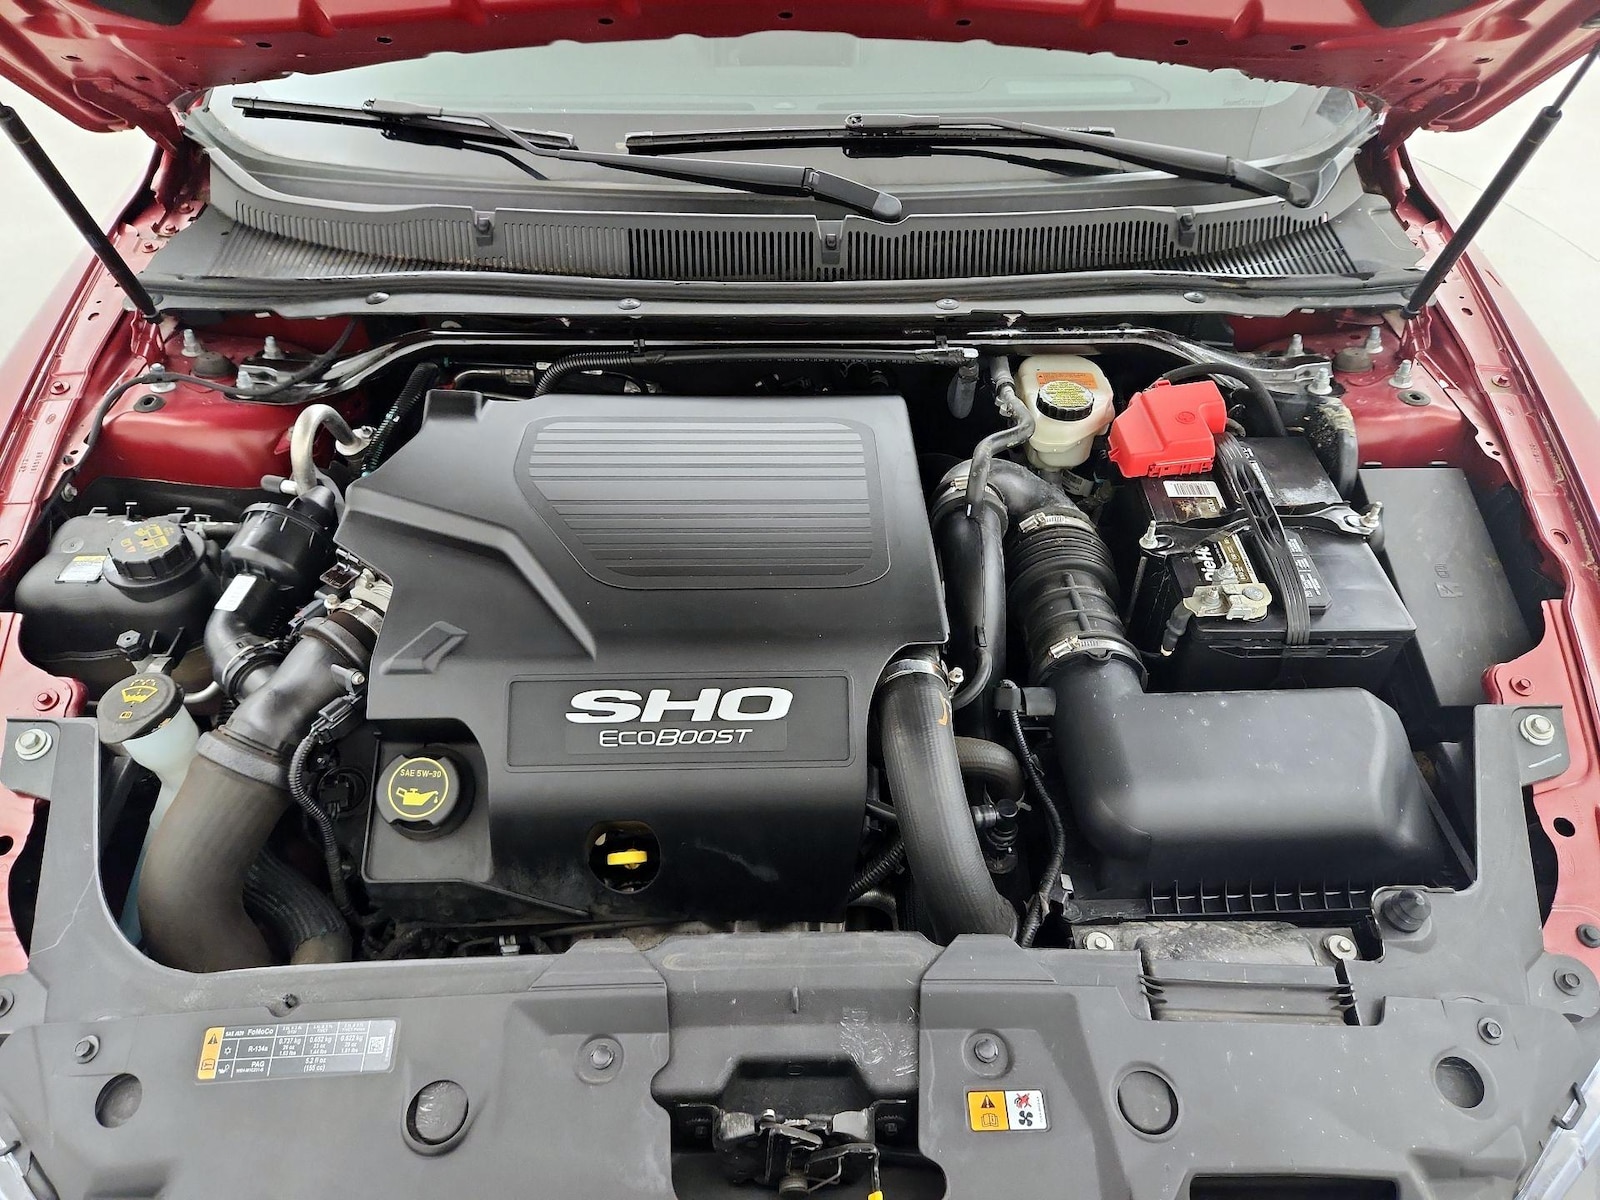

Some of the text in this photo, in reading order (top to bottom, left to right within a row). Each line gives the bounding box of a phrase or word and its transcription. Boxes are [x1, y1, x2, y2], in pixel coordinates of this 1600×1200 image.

[565, 687, 794, 723] SHO
[400, 769, 442, 778] SAE 5W-30
[248, 1045, 269, 1053] R-134a
[316, 1064, 326, 1072] cc)
